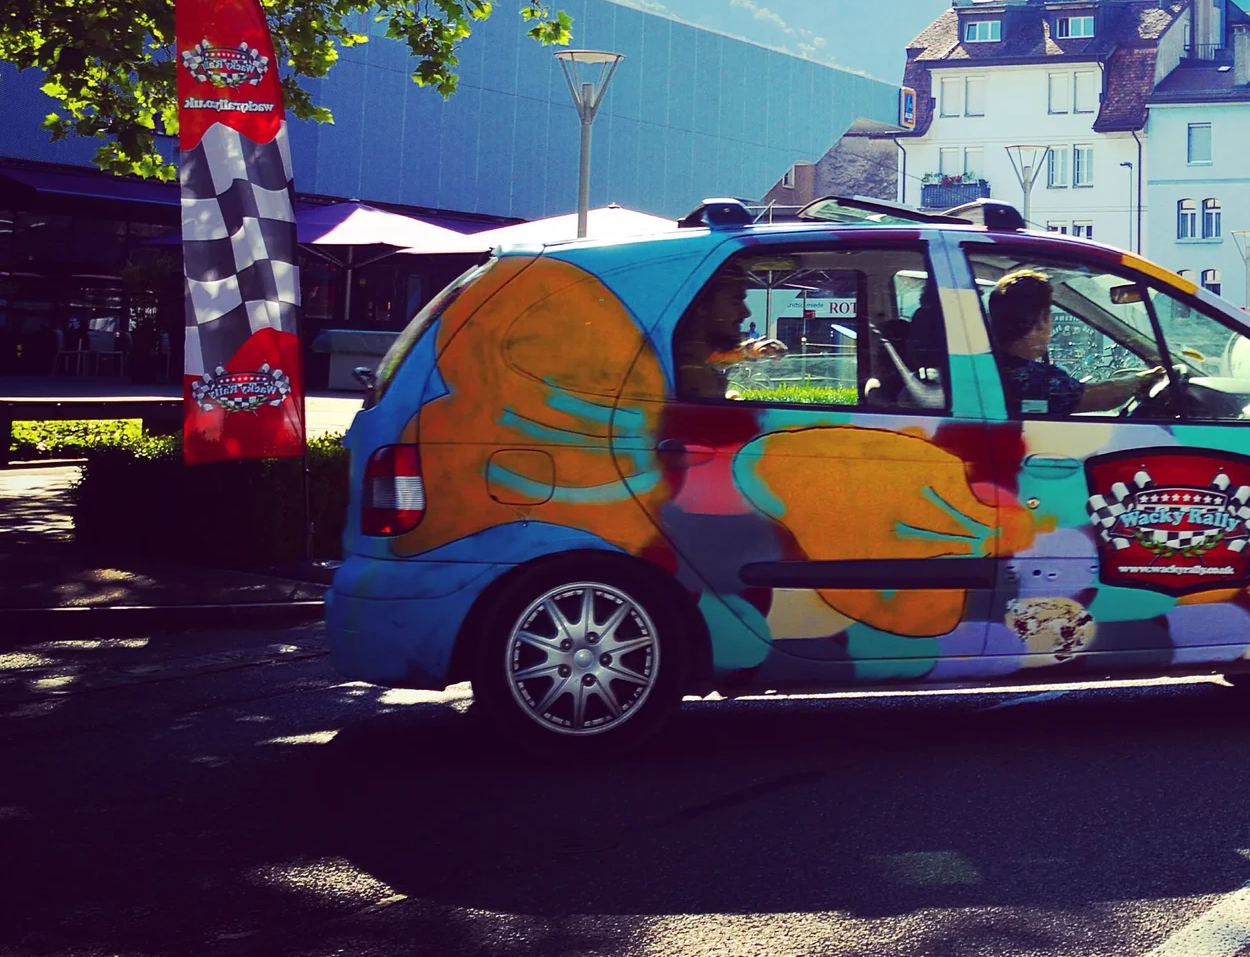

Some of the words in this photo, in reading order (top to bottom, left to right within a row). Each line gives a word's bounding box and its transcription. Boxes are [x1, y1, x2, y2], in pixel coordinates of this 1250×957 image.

[1120, 507, 1185, 528] Wacky
[1187, 508, 1241, 532] Rally
[1117, 564, 1236, 576] www.wackyrally.co.uk
